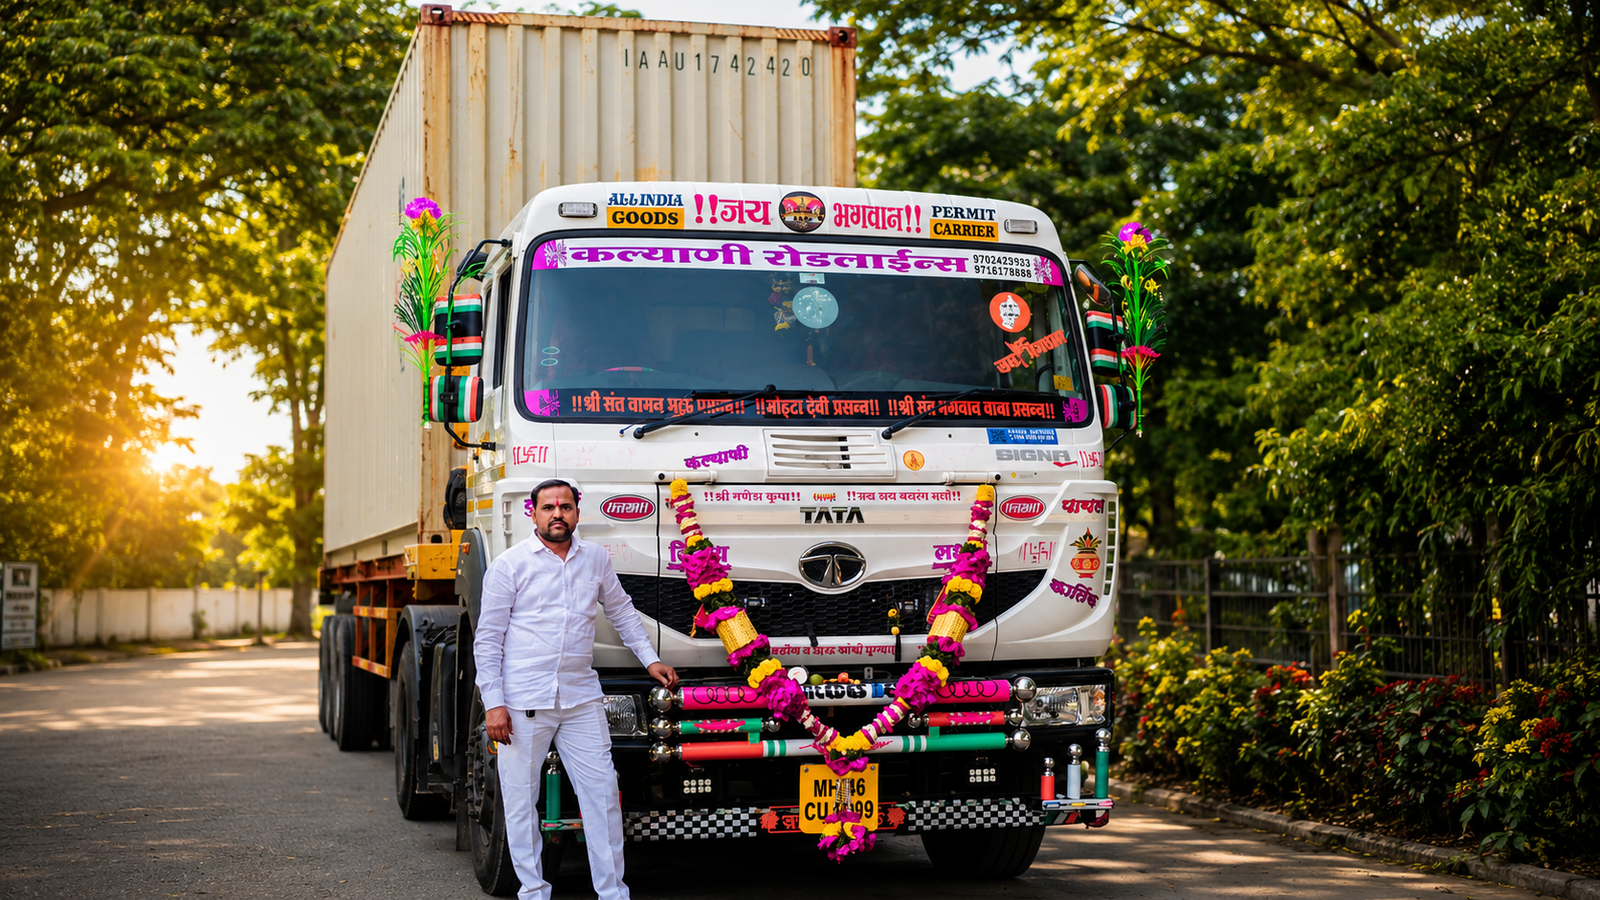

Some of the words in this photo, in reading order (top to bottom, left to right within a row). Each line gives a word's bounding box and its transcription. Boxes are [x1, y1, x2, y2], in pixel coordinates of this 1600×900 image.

[639, 193, 684, 207] INDIA
[612, 211, 679, 225] GOODS
[931, 205, 996, 221] PERMIT
[933, 222, 996, 238] CARRIER
[569, 243, 753, 266] कल्याणी
[763, 244, 968, 273] रोडलाईन्स
[602, 391, 625, 412] संत
[805, 395, 829, 418] देवी
[916, 394, 936, 416] संत
[996, 449, 1071, 462] SIGNA
[800, 506, 865, 524] TATA
[814, 779, 840, 797] MH
[804, 801, 829, 821] CU
